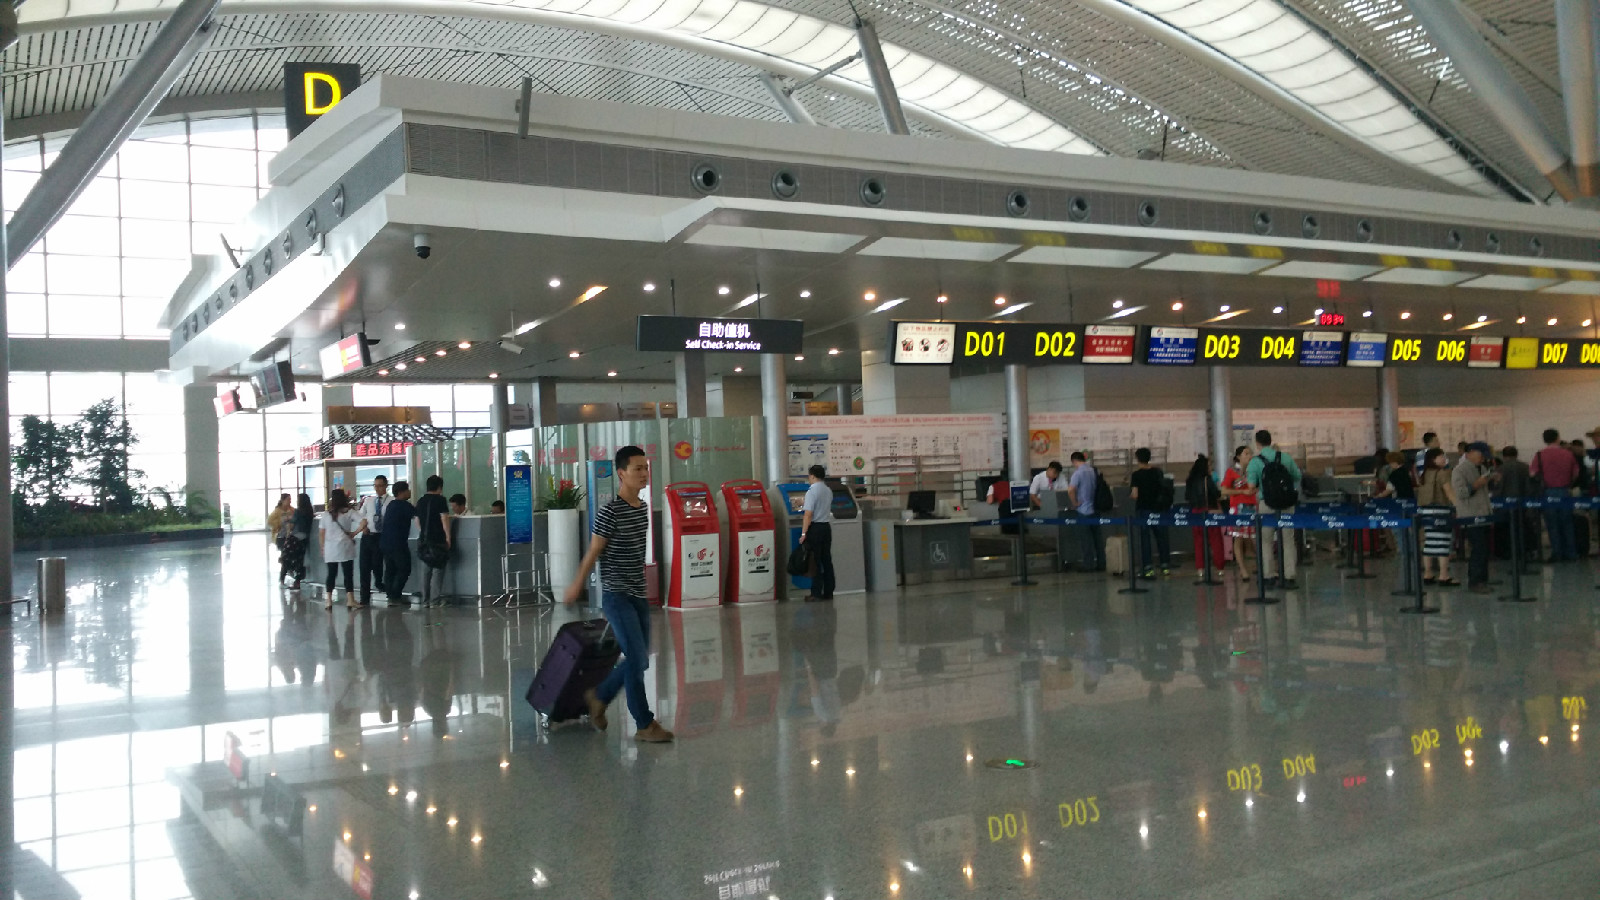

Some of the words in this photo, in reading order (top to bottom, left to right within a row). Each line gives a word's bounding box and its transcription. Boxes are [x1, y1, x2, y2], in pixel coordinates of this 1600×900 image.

[304, 72, 342, 115] D
[699, 322, 751, 338] 自助值机
[685, 339, 701, 349] Self
[701, 340, 734, 350] Check-in
[735, 340, 761, 351] Service
[965, 331, 1006, 356] D01
[1035, 332, 1076, 357] D02
[1204, 335, 1241, 359] D03
[1261, 336, 1295, 359] D04
[1391, 339, 1422, 361] D05
[1436, 340, 1466, 362] D06
[1543, 343, 1569, 364] D07
